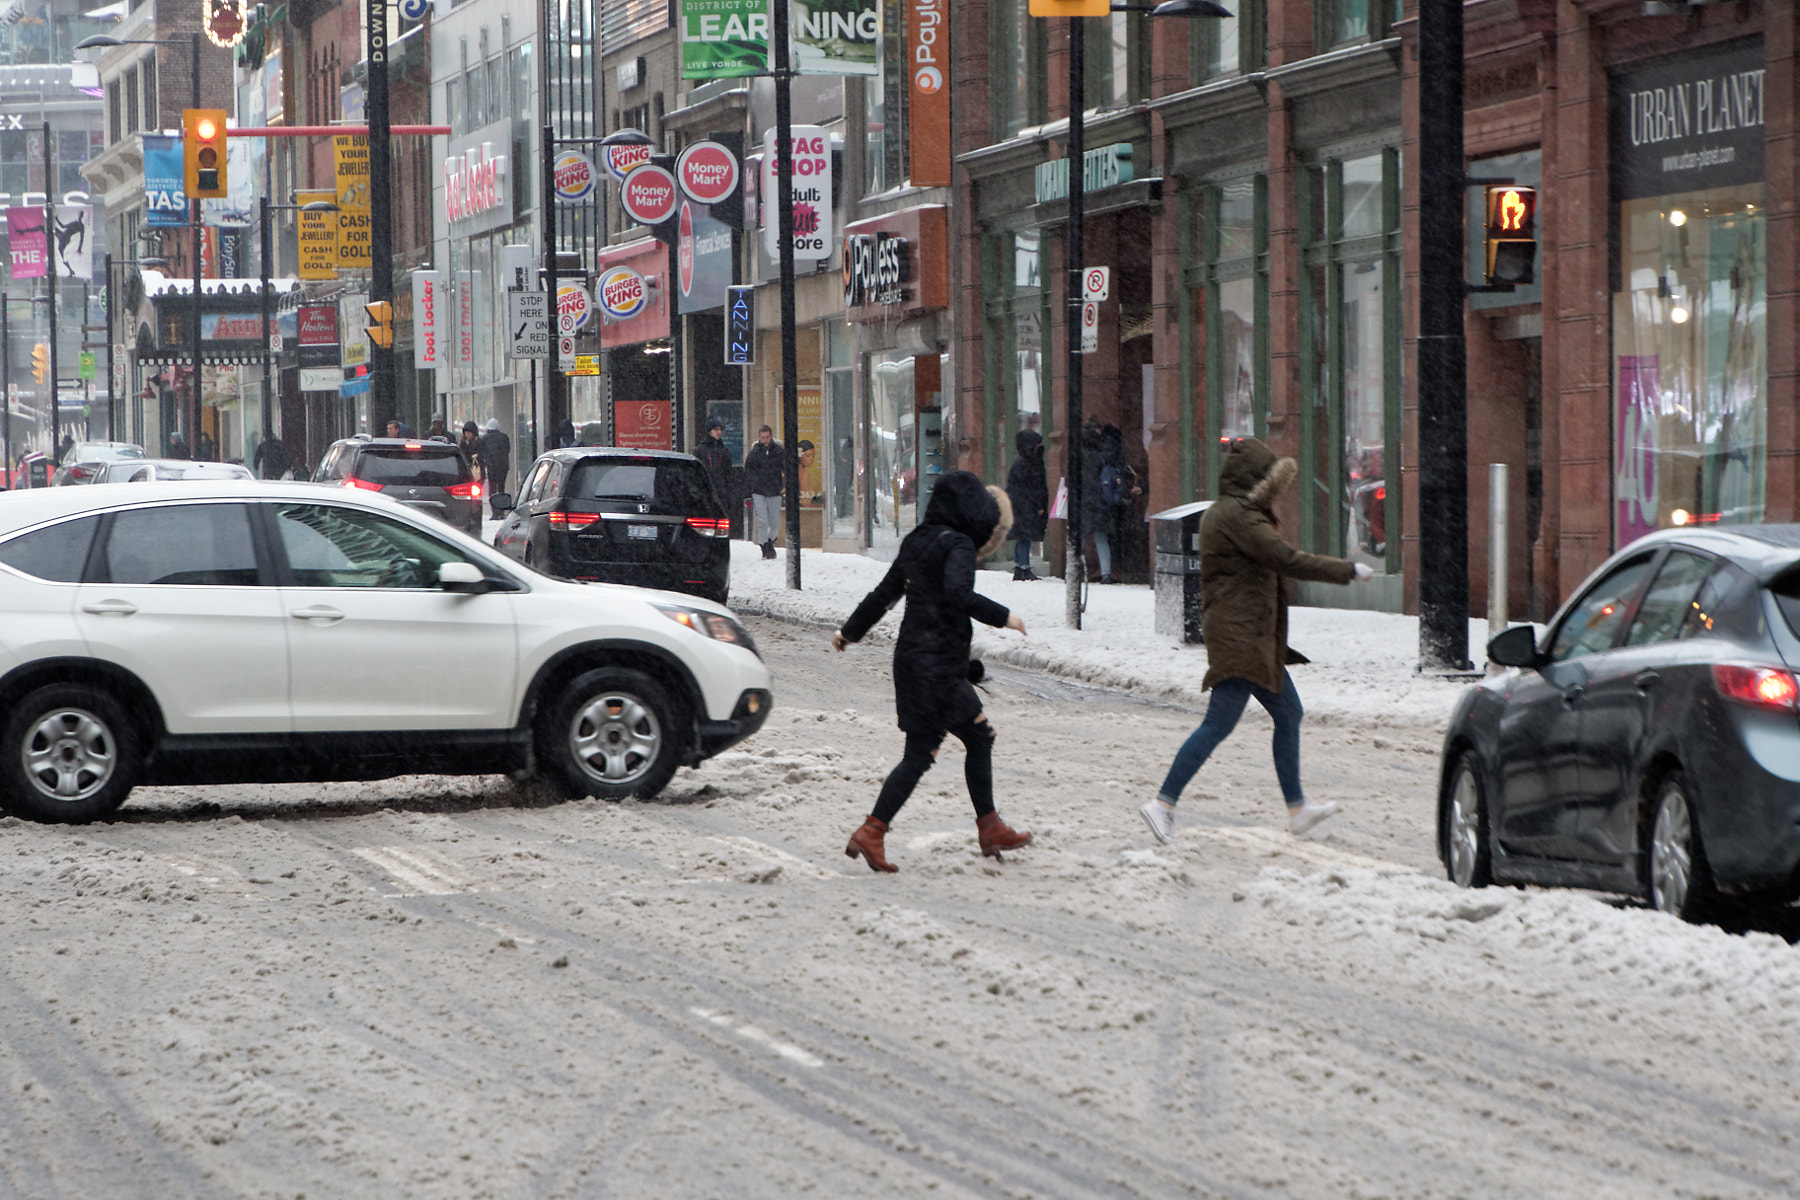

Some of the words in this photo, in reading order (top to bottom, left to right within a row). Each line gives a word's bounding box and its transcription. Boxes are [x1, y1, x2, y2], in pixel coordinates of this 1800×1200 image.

[686, 1, 744, 10] DISTRICT
[746, 0, 761, 9] OF
[711, 60, 743, 68] YONGE
[1630, 82, 1691, 146] URBAN
[1696, 69, 1766, 135] PLANET
[336, 137, 349, 146] WE
[340, 150, 368, 159] YOUR
[613, 148, 650, 170] KING
[338, 162, 370, 175] JEWELLER
[554, 162, 588, 179] BURGER
[688, 163, 729, 176] Money
[556, 170, 590, 190] KING
[693, 174, 721, 185] Mart
[632, 185, 670, 197] Money
[791, 188, 821, 202] dult
[636, 197, 662, 206] Mart
[303, 212, 322, 221] BUY
[340, 215, 372, 228] CASH
[300, 231, 335, 241] JEWELLERY
[347, 231, 368, 242] FOR
[776, 238, 823, 249] sore
[304, 246, 333, 254] CASH
[10, 250, 40, 264] THE
[605, 277, 641, 296] BURGER
[520, 297, 543, 306] STOP
[557, 291, 583, 306] URGER
[607, 285, 642, 308] KING
[422, 280, 434, 326] Locker
[309, 311, 326, 320] Tim
[520, 309, 543, 318] HERE
[301, 322, 334, 332] Hortons
[535, 321, 547, 330] ON
[530, 333, 547, 341] RED
[424, 331, 435, 361] Foot
[516, 345, 548, 354] SIGNAL
